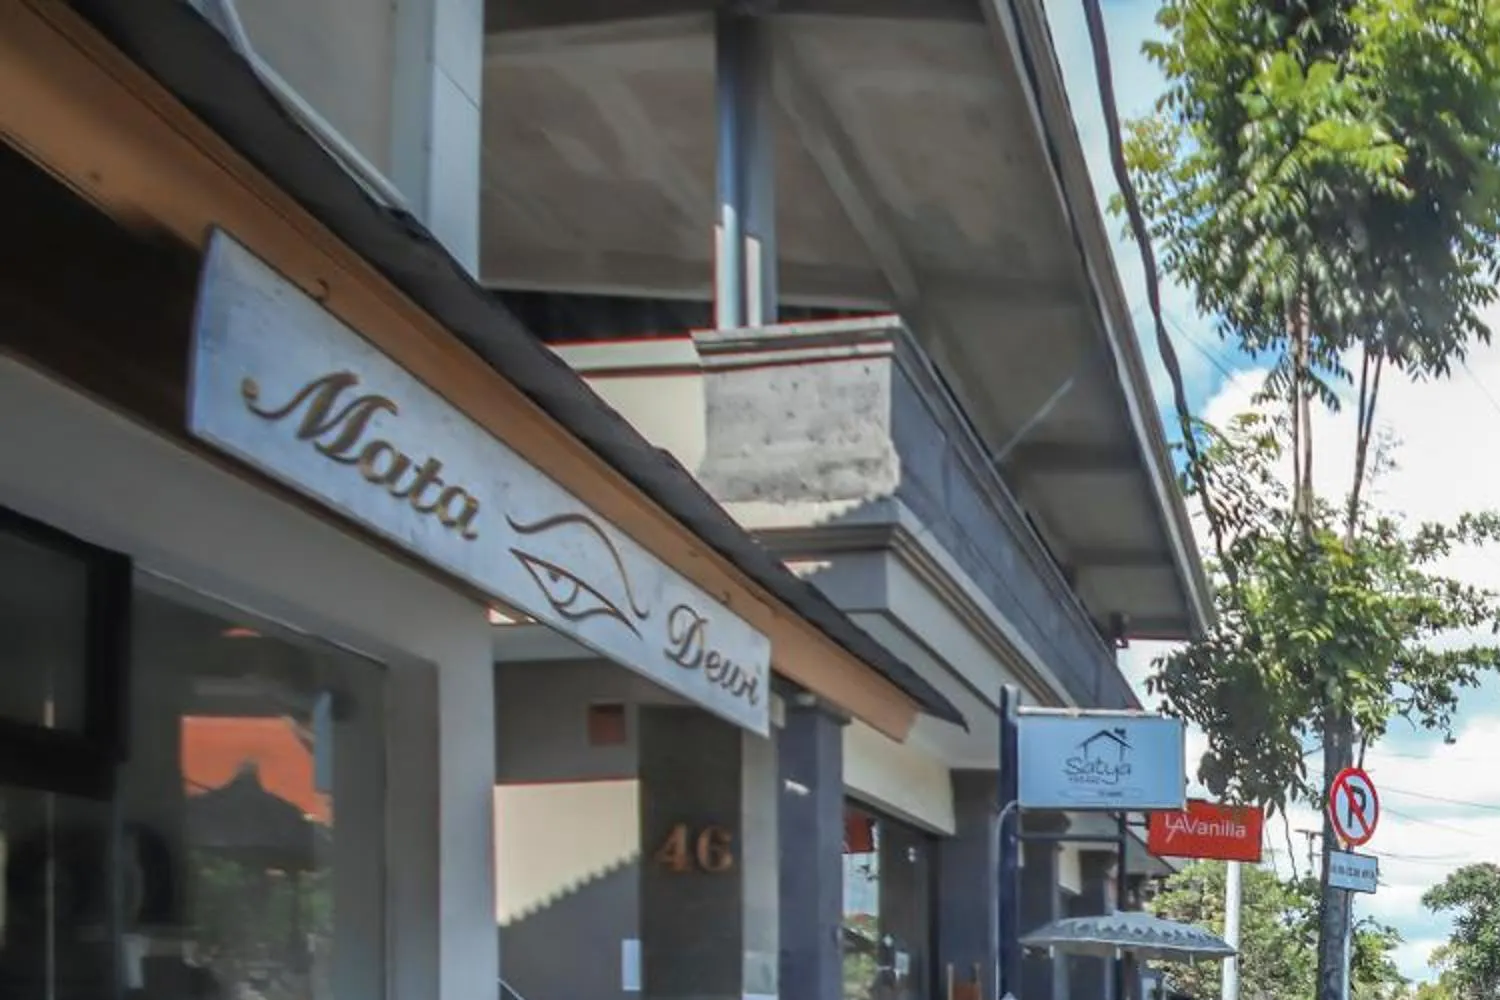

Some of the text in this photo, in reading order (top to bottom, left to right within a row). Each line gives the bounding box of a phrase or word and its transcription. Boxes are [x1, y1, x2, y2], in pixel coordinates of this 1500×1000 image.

[241, 368, 761, 706] Mata Dewi
[1061, 756, 1132, 785] Satya
[1347, 784, 1367, 829] P
[654, 821, 733, 871] 46
